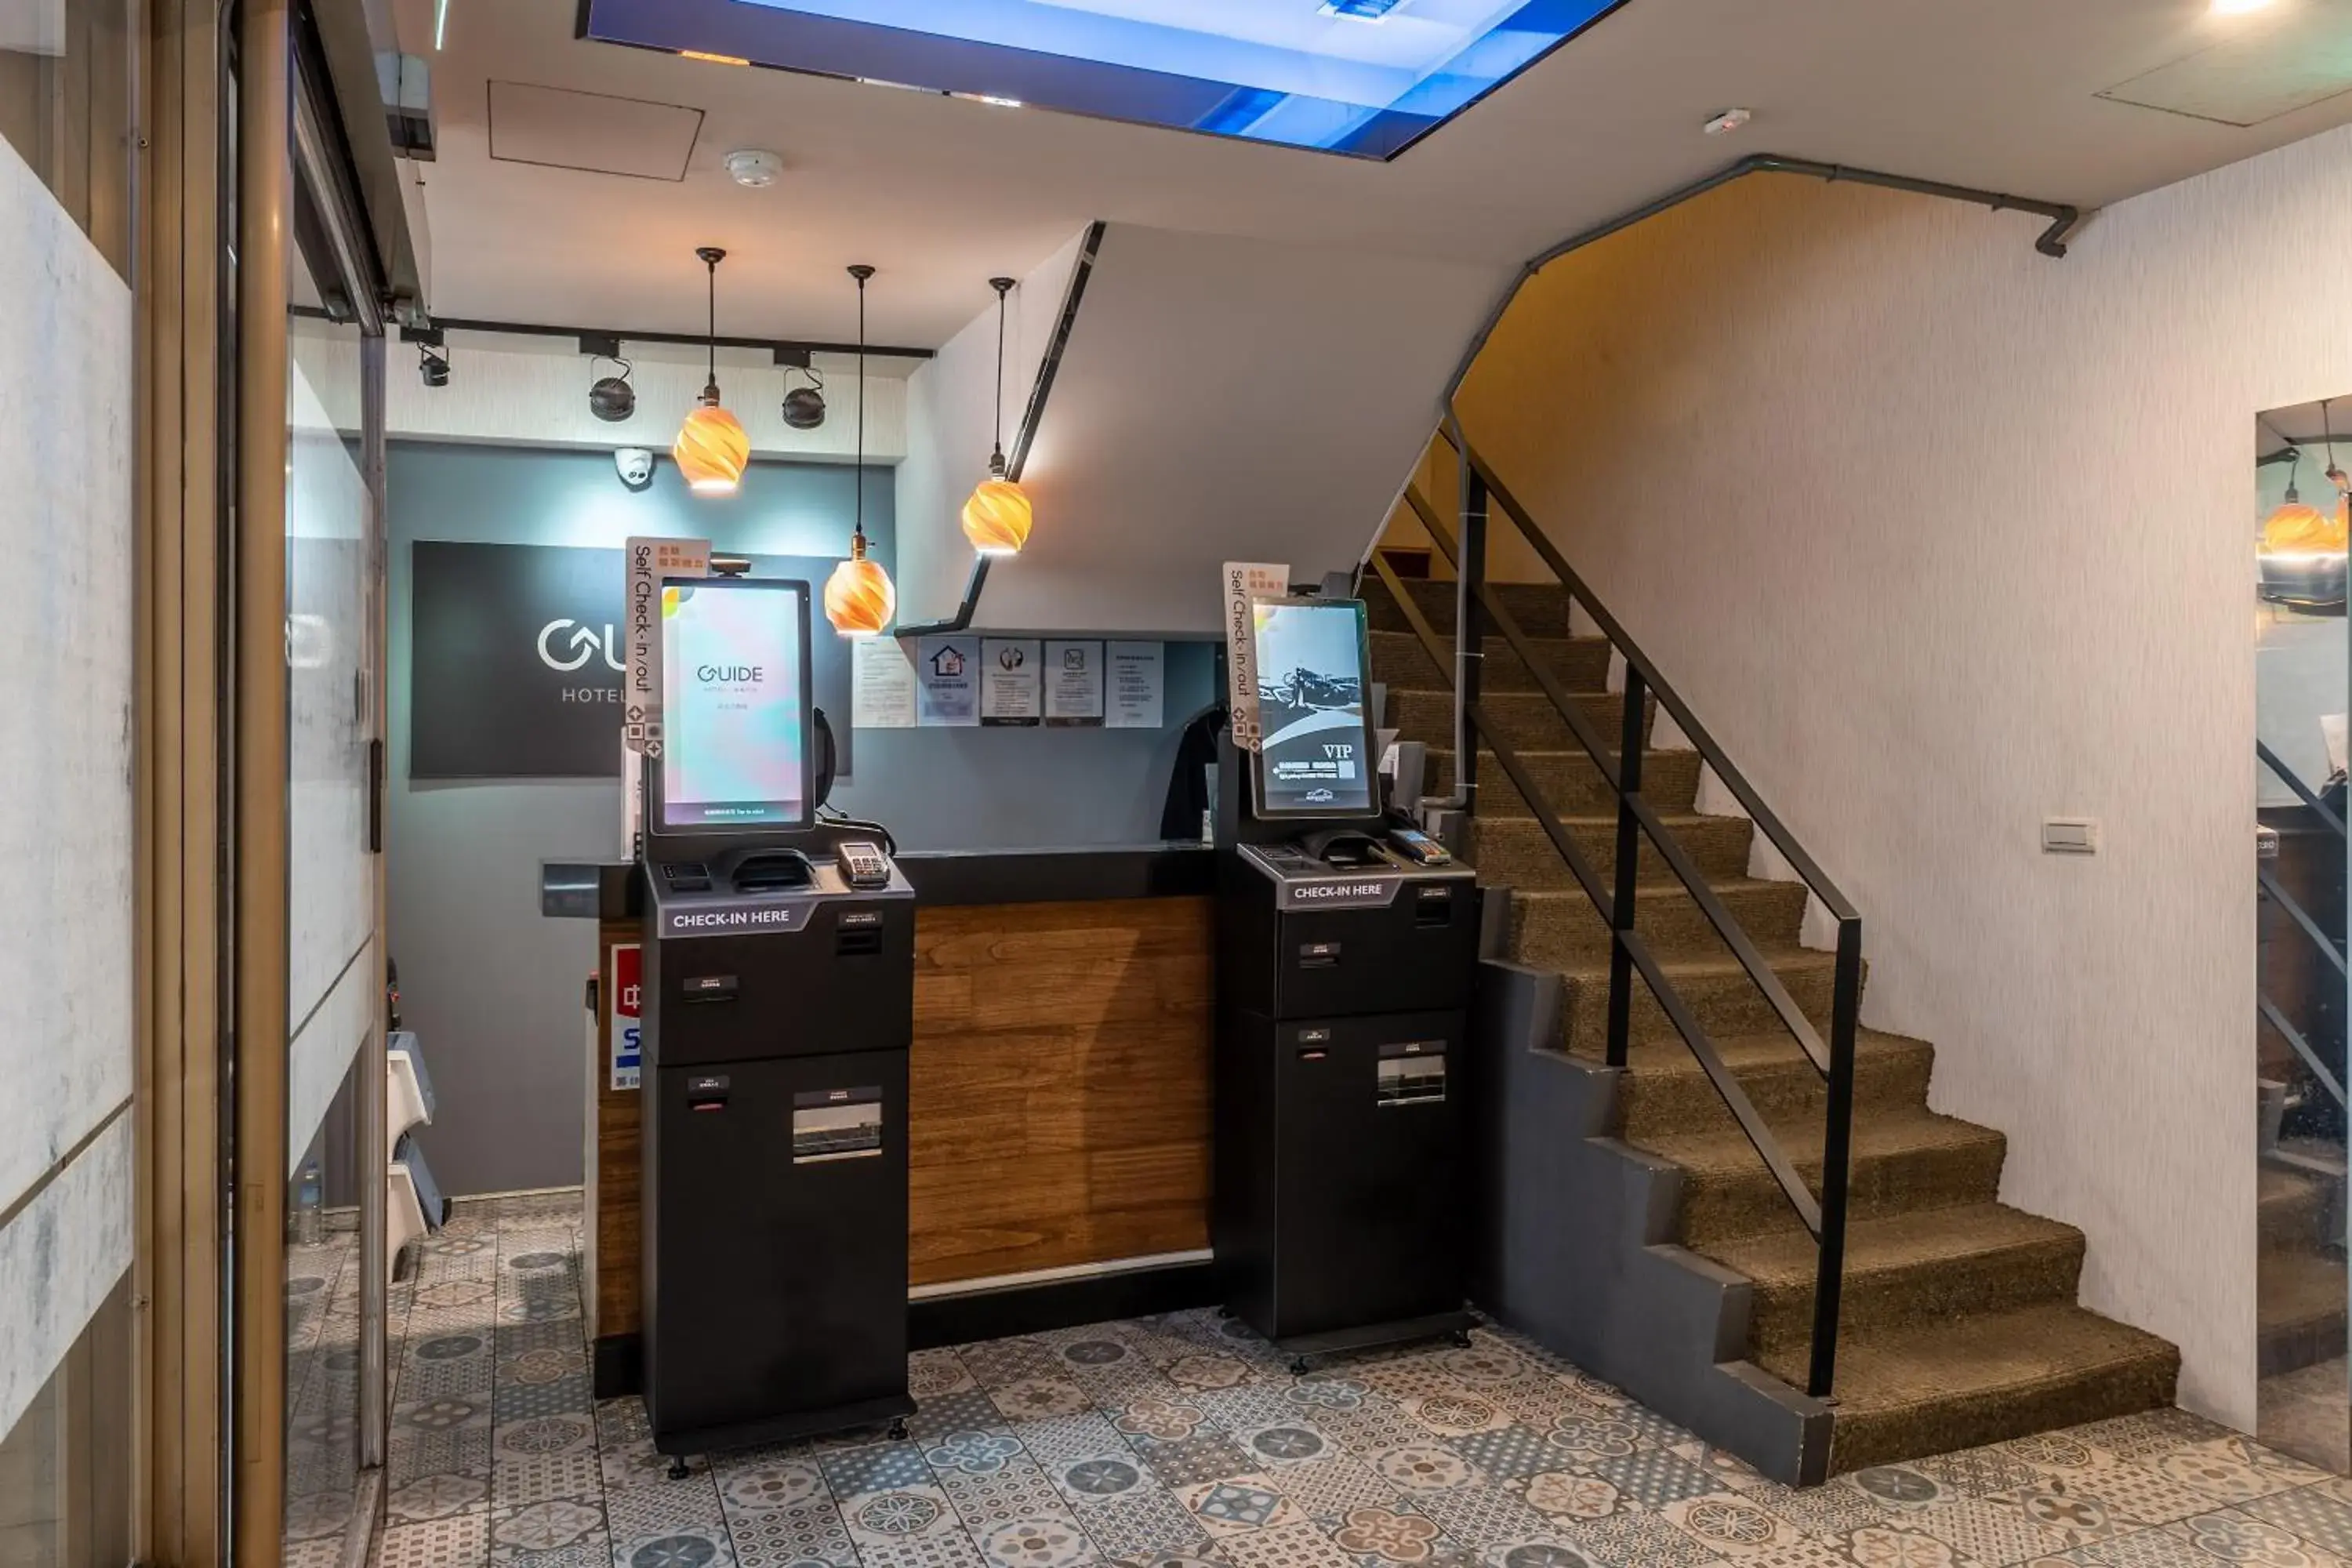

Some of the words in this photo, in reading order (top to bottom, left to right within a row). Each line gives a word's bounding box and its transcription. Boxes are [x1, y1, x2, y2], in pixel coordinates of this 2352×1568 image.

[635, 545, 652, 579] Self
[1231, 570, 1245, 599] Self
[697, 665, 763, 682] GUIDE
[1322, 744, 1352, 759] VIP
[1294, 886, 1351, 898] CHECK-IN
[1352, 884, 1382, 895] HERE
[673, 912, 747, 927] CHECK-IN
[751, 910, 789, 924] HERE
